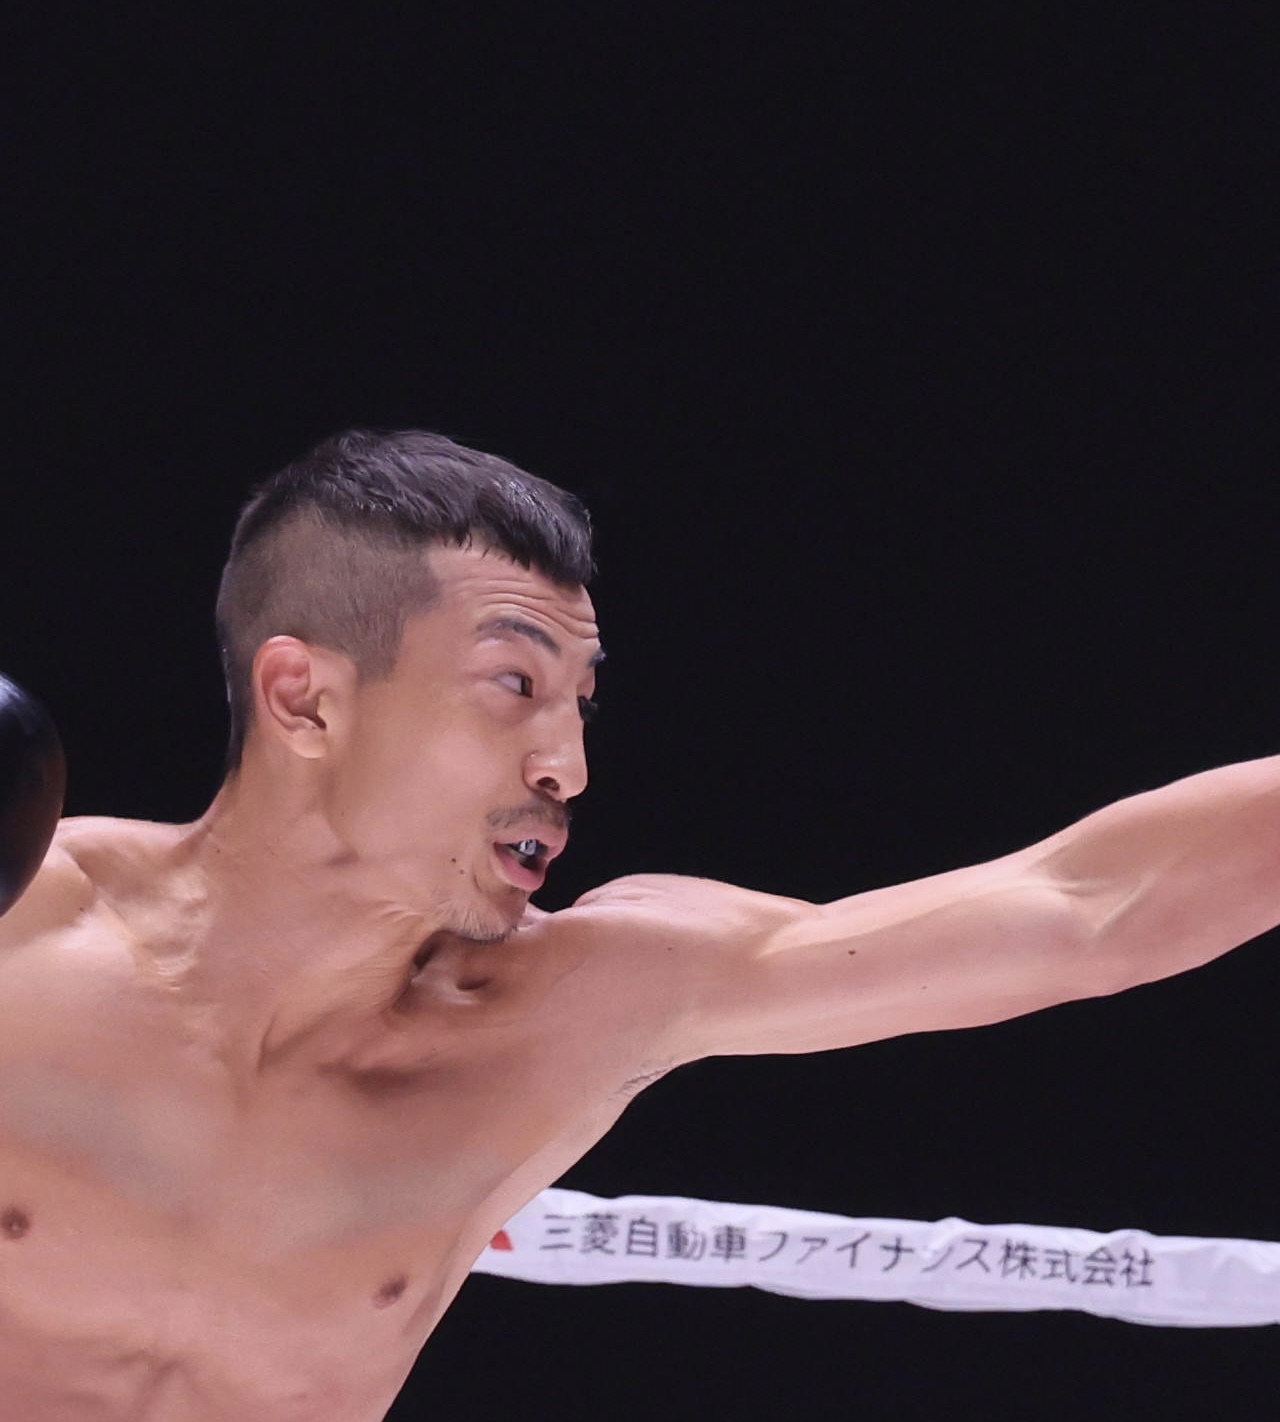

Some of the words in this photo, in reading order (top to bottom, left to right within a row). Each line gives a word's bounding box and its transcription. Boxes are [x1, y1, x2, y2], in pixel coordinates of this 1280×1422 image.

[539, 1211, 1155, 1289] 三菱自動車ファイナンス株式会社
